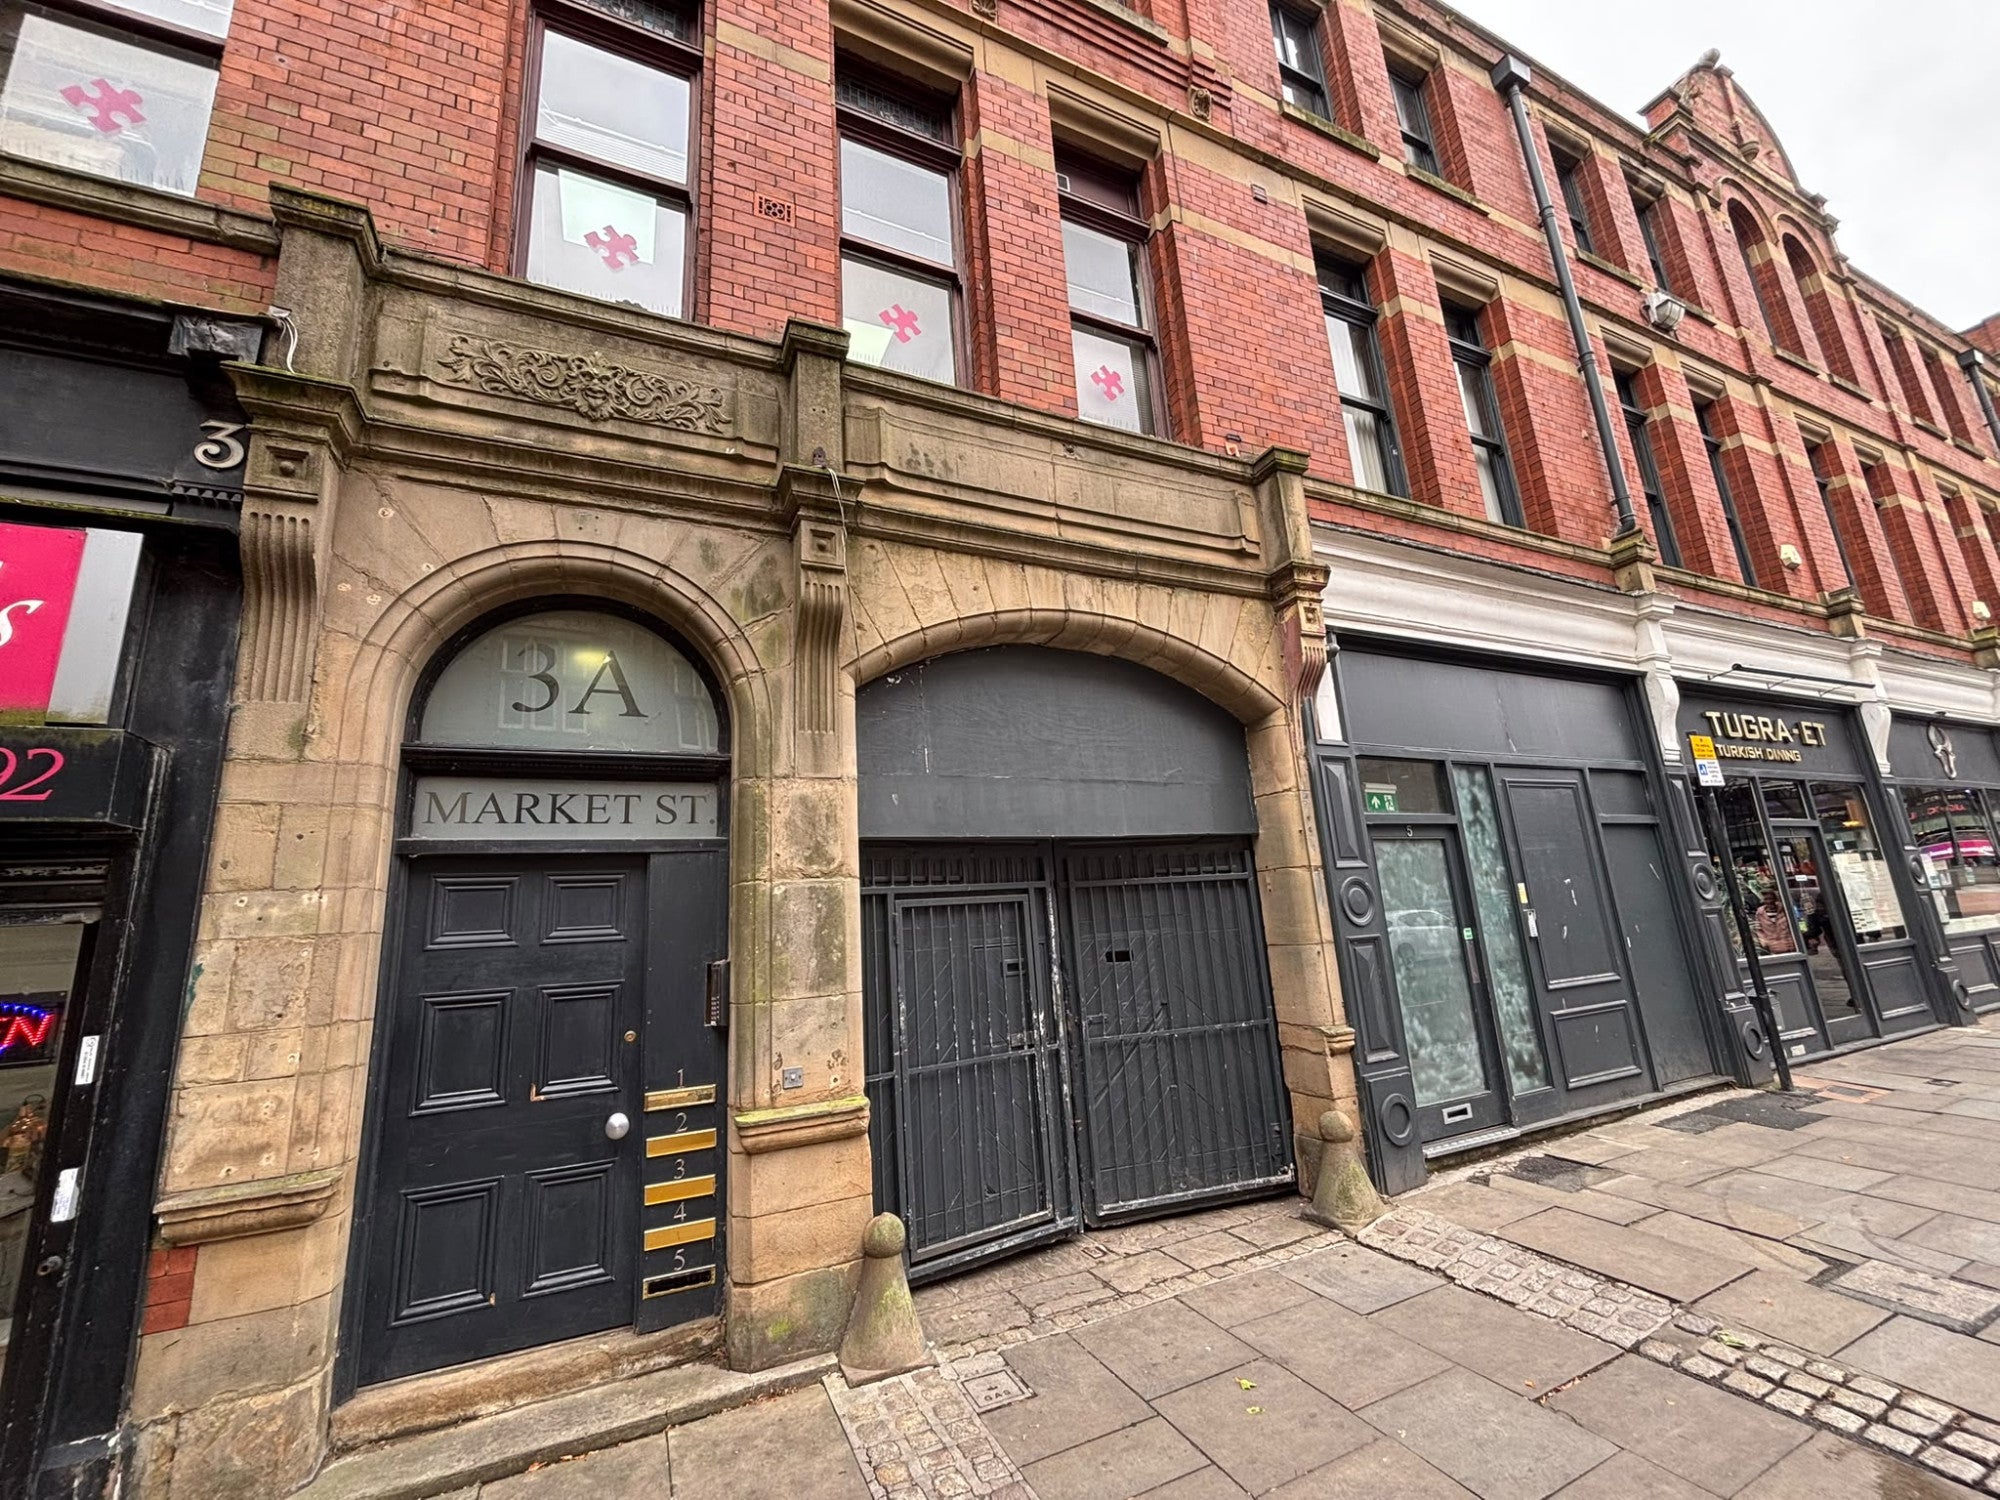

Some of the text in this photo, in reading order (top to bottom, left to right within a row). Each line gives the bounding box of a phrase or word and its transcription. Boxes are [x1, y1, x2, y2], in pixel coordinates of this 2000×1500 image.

[194, 420, 245, 469] 3
[511, 644, 649, 718] 3A
[1715, 743, 1802, 762] TURKISH DINING
[422, 791, 717, 825] MARKET ST.
[676, 1069, 686, 1087] 1
[675, 1112, 689, 1133] 2
[673, 1158, 687, 1179] 3
[672, 1202, 688, 1222] 4
[673, 1248, 687, 1271] 5
